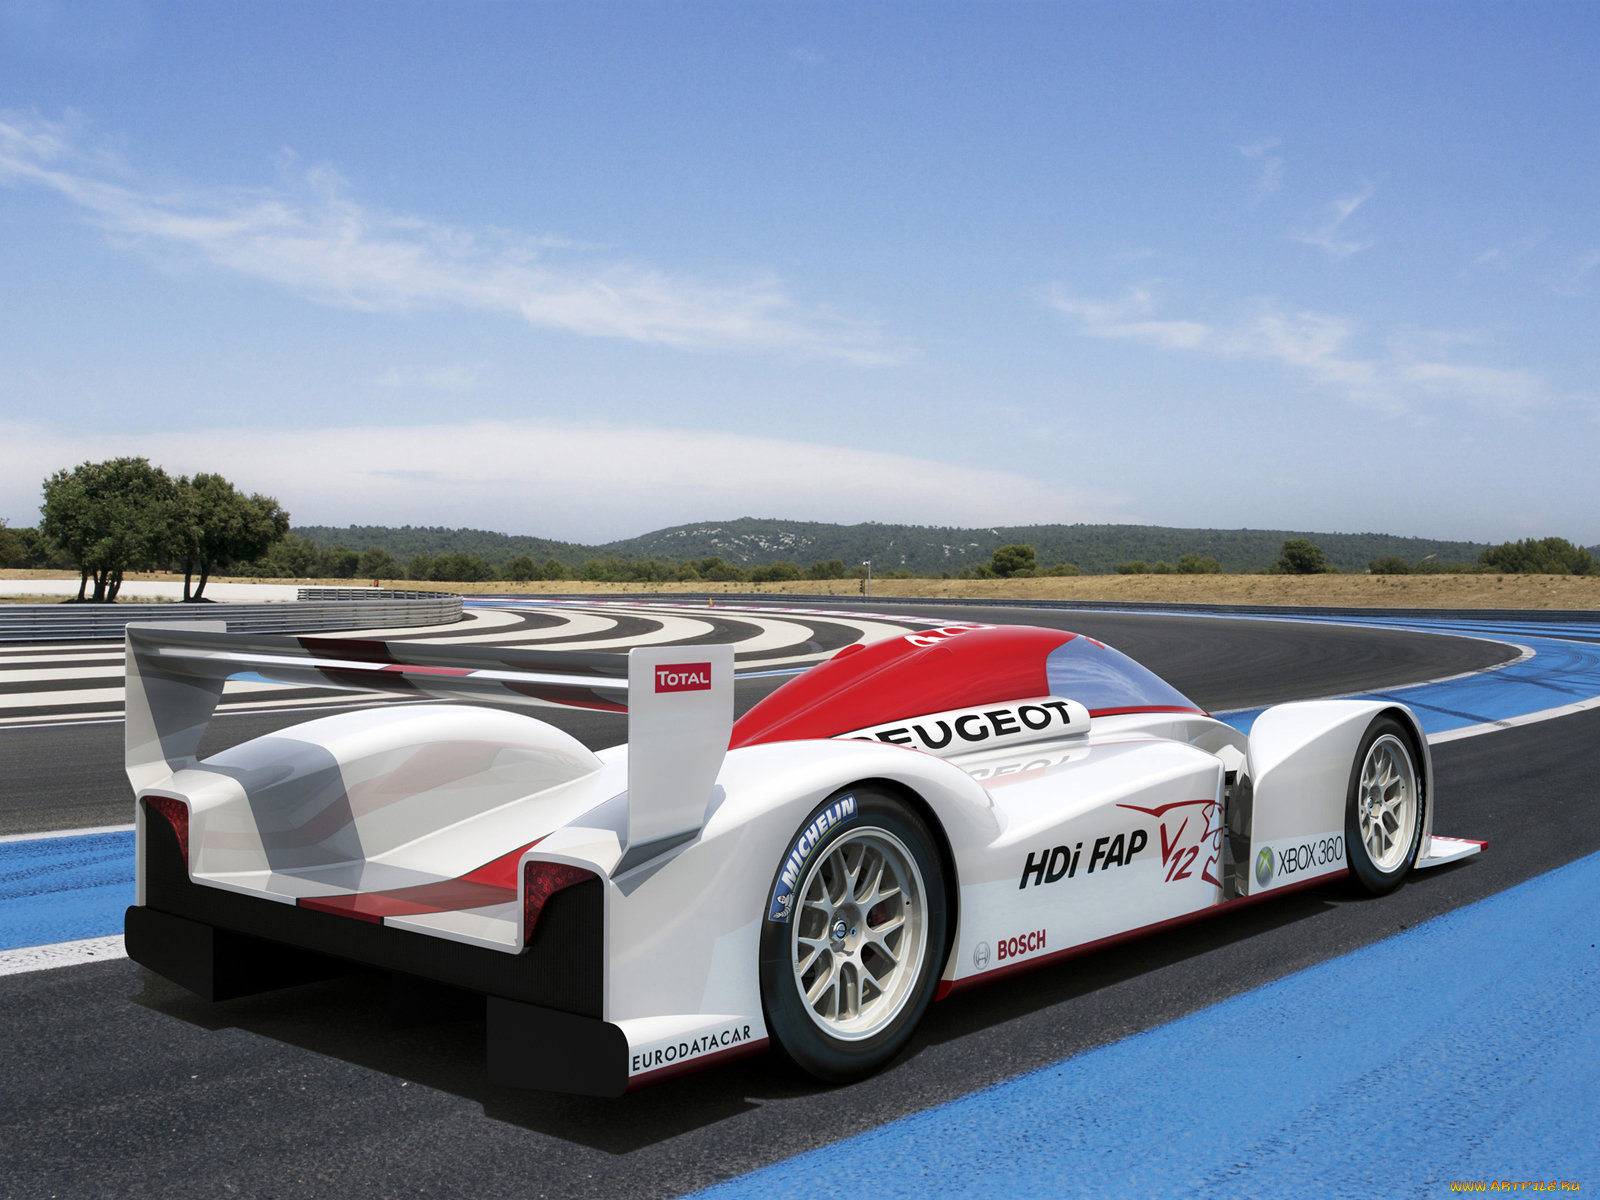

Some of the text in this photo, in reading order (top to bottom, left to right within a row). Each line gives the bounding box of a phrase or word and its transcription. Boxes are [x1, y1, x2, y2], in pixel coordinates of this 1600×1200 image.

[656, 671, 709, 686] TOTAL
[851, 701, 1069, 750] EUGEOT
[781, 796, 855, 890] MICHELIN
[1019, 829, 1148, 890] HDi FAP
[1278, 835, 1344, 877] XBOX 360
[997, 929, 1047, 961] BOSCH
[632, 1025, 751, 1071] EURODATACAR
